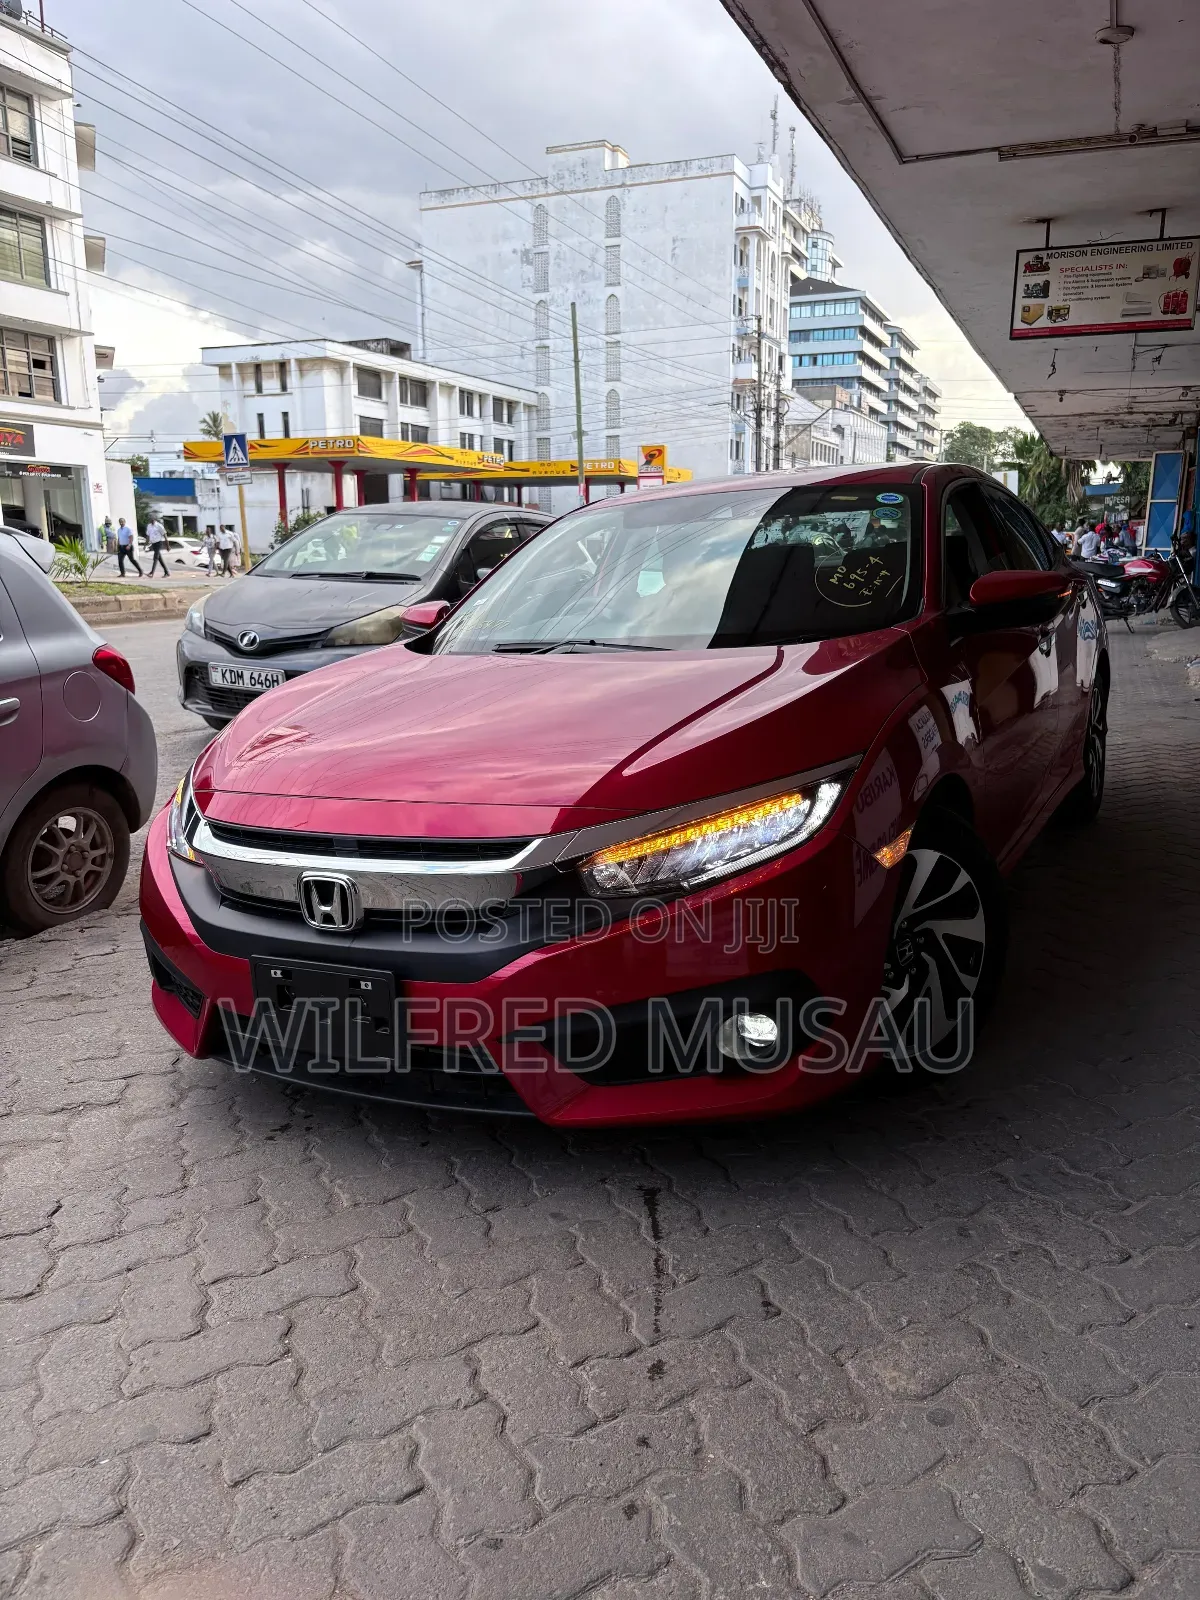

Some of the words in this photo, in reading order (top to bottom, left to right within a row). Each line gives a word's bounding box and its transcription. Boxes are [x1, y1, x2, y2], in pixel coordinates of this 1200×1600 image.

[1045, 249, 1088, 260] MORISON
[1090, 244, 1154, 257] ENGINEERING
[1156, 241, 1194, 252] LIMITED
[1059, 263, 1114, 274] SPECIALISTS
[308, 438, 355, 450] PETRO
[220, 668, 245, 686] KDM
[249, 672, 280, 689] 646H
